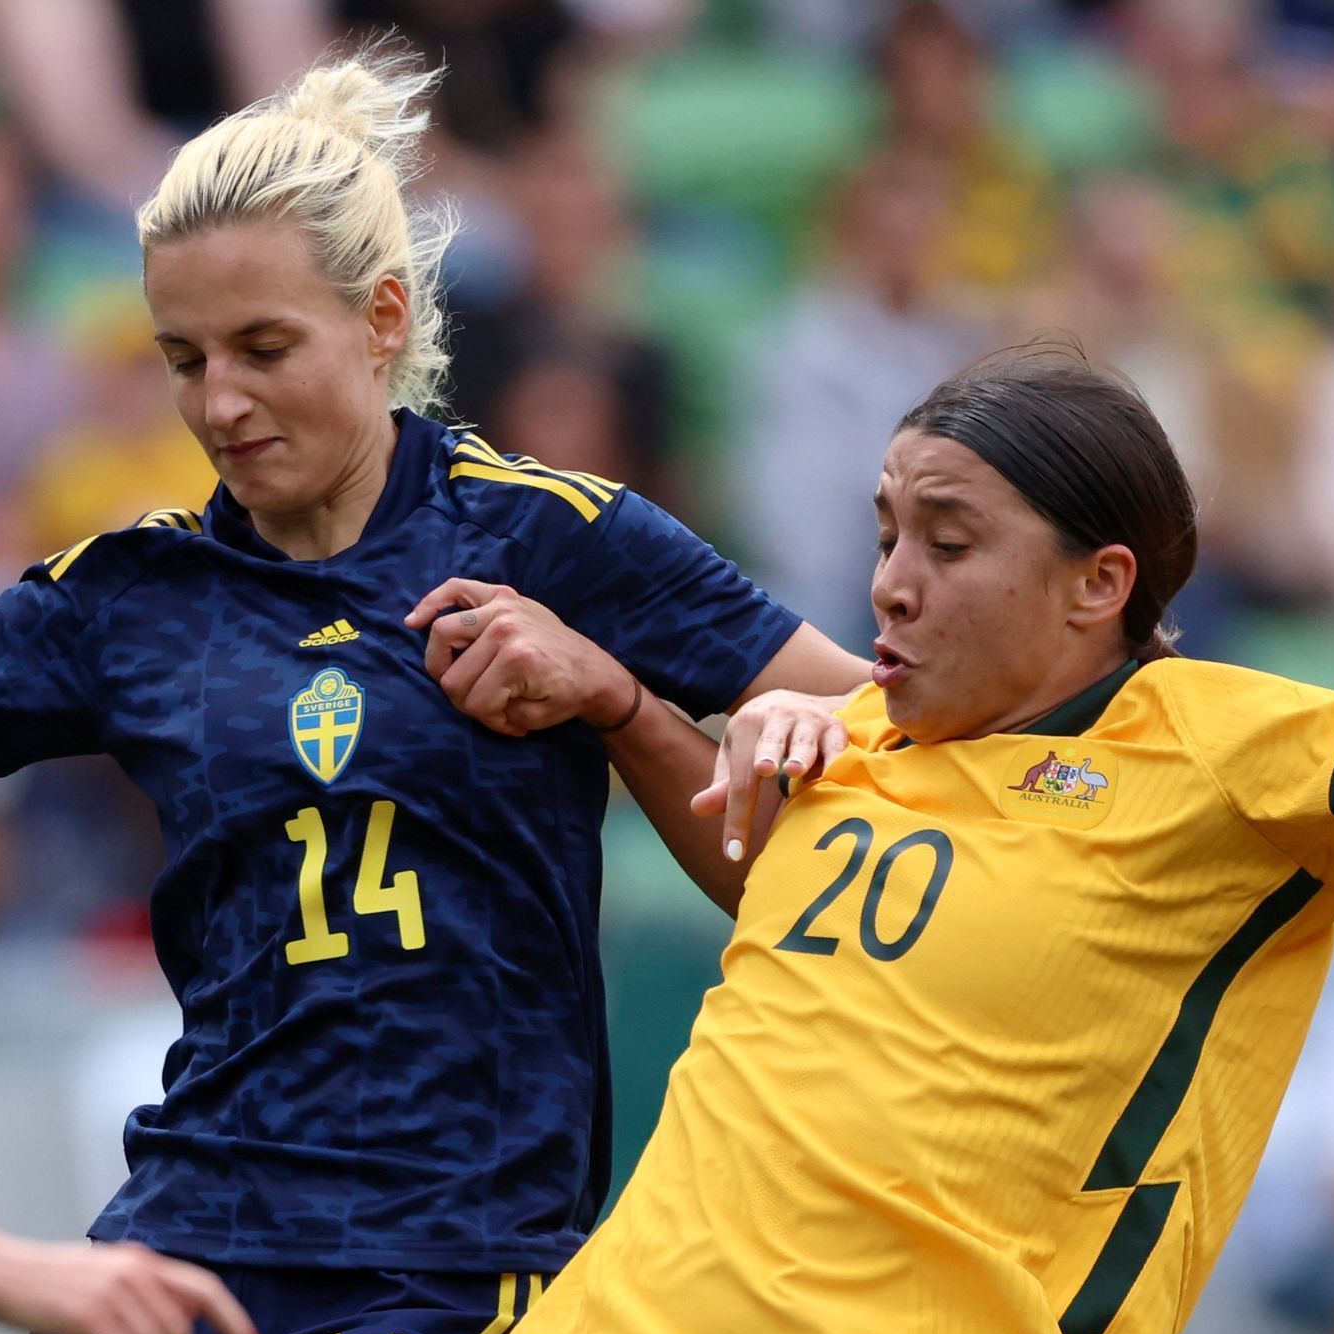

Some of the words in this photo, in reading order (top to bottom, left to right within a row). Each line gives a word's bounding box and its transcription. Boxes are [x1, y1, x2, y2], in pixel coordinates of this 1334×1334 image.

[303, 699, 352, 713] SVERIGE
[1019, 792, 1090, 809] AUSTRALIA
[284, 800, 426, 966] 14
[772, 817, 954, 962] 20
